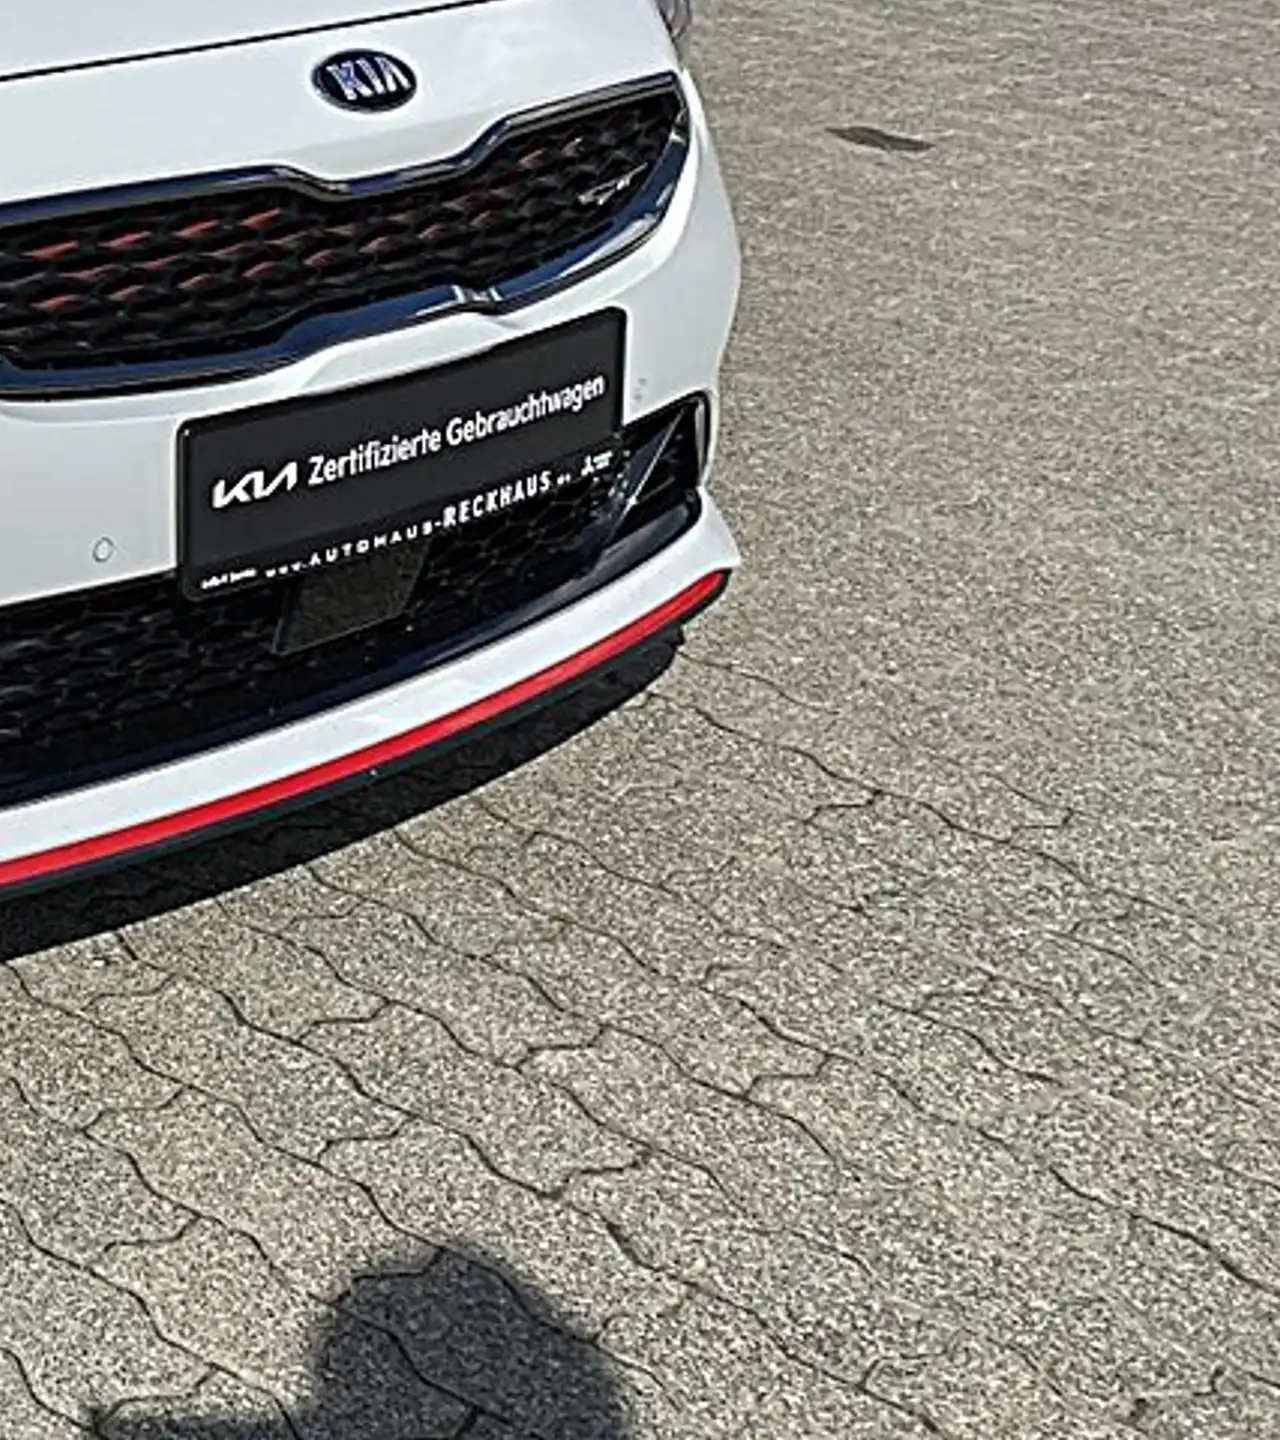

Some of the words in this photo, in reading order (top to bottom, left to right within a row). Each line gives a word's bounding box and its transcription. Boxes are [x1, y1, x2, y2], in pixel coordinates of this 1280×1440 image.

[325, 56, 412, 101] KIA
[211, 460, 299, 509] KIA
[307, 427, 442, 486] Zertifizierte
[445, 374, 607, 446] Gebrauchtwagen
